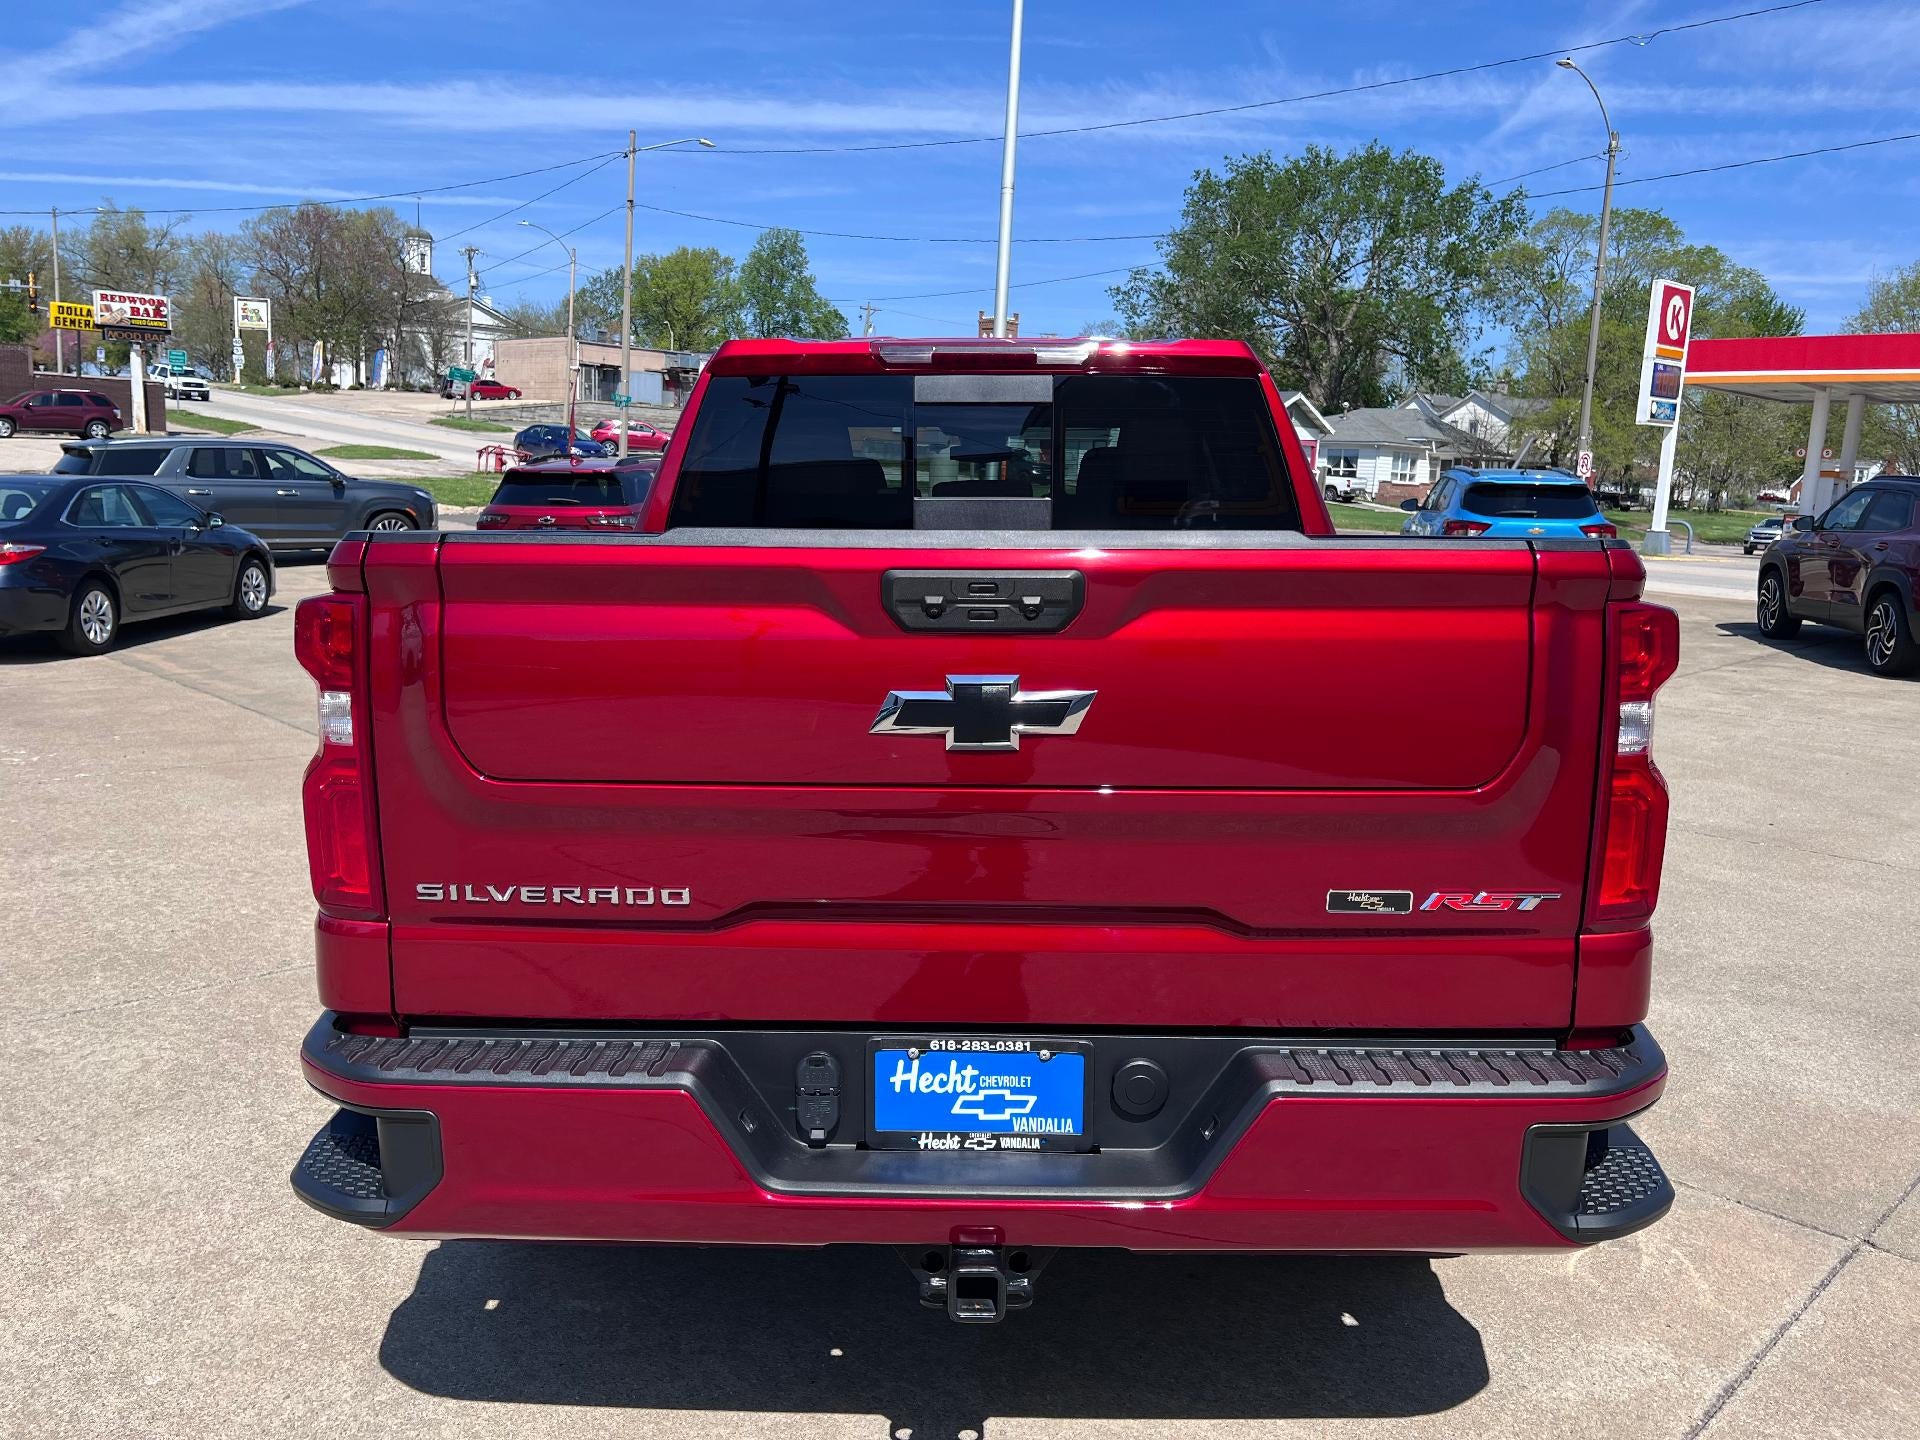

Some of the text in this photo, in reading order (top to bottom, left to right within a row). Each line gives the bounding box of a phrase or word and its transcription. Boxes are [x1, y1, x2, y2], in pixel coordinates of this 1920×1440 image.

[100, 293, 166, 307] REDWOOD
[57, 305, 93, 318] DOLLA
[130, 306, 164, 318] BAR
[54, 316, 96, 329] GENER
[1670, 304, 1682, 339] K
[416, 883, 691, 905] SILVERADO
[1419, 891, 1561, 911] RST
[930, 1040, 1031, 1052] 618-283-0381
[889, 1059, 1032, 1094] Hecht CHEVROLET
[1012, 1117, 1074, 1134] VANDALIA
[918, 1132, 1040, 1150] Hecht VANDALIA
